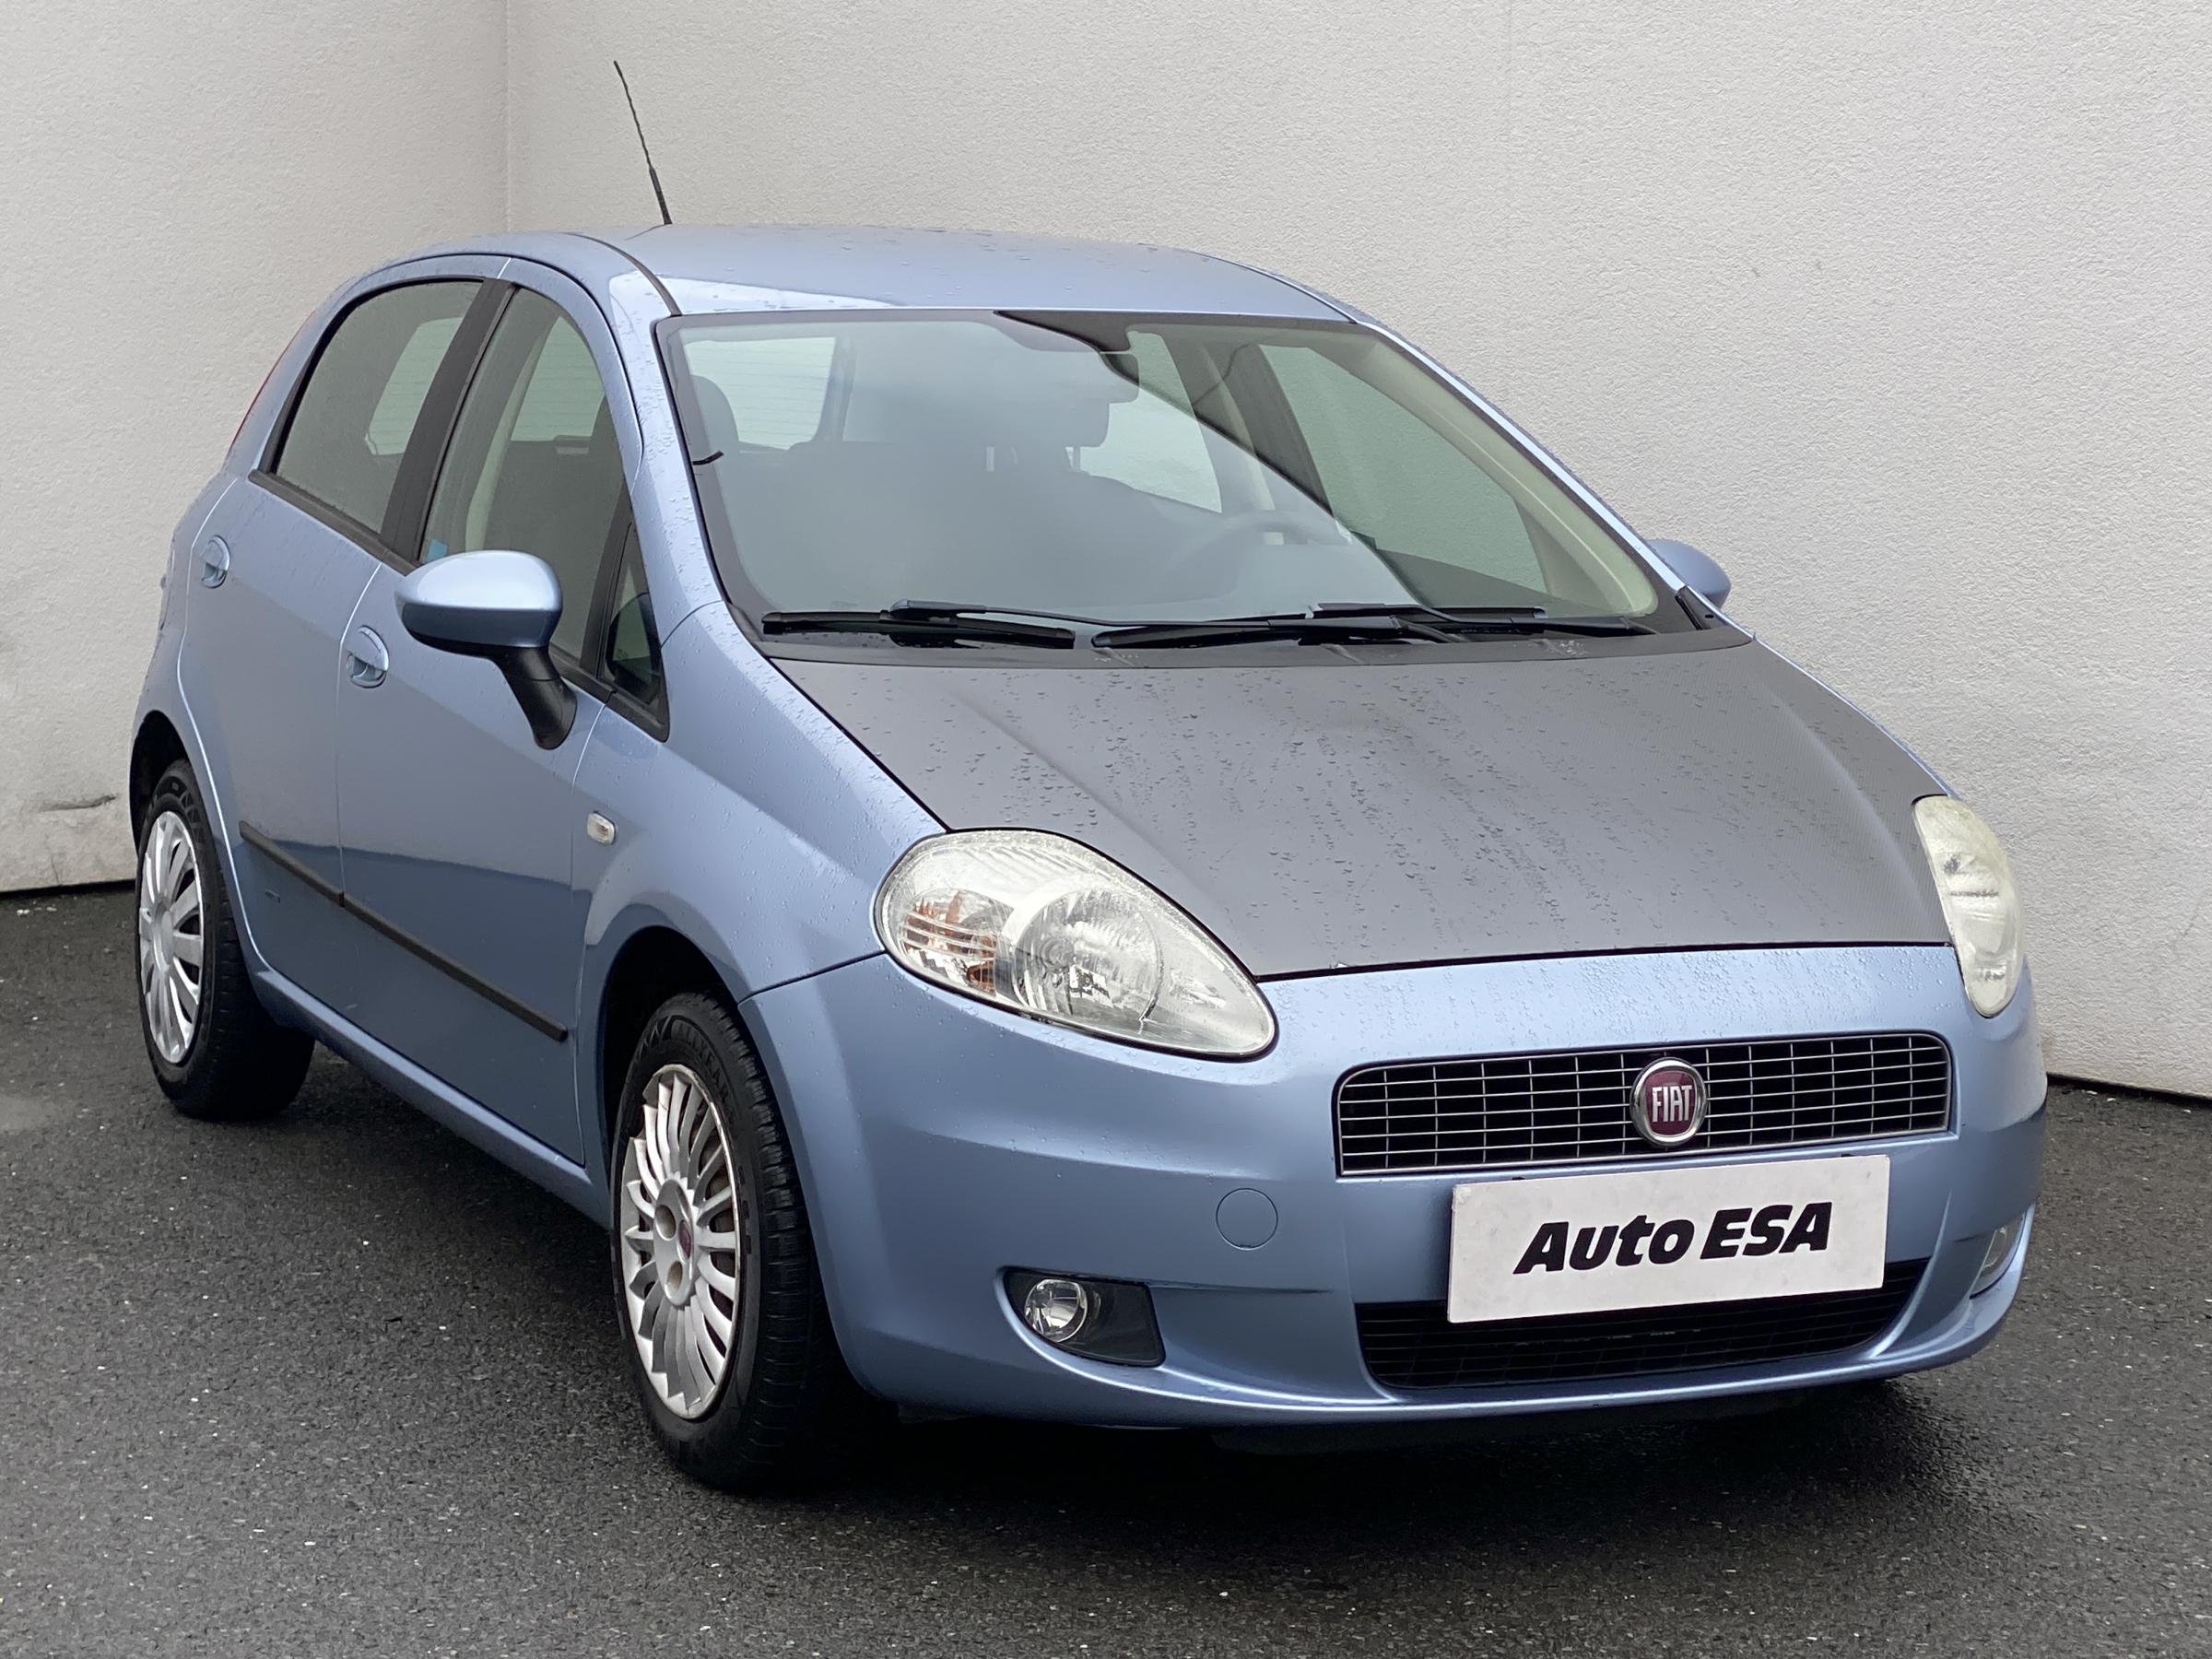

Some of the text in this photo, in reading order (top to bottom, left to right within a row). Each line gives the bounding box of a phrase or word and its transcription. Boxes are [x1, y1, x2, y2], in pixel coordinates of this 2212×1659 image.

[1652, 1085, 1693, 1123] FIAT
[1512, 1202, 1832, 1275] Auto ESA
